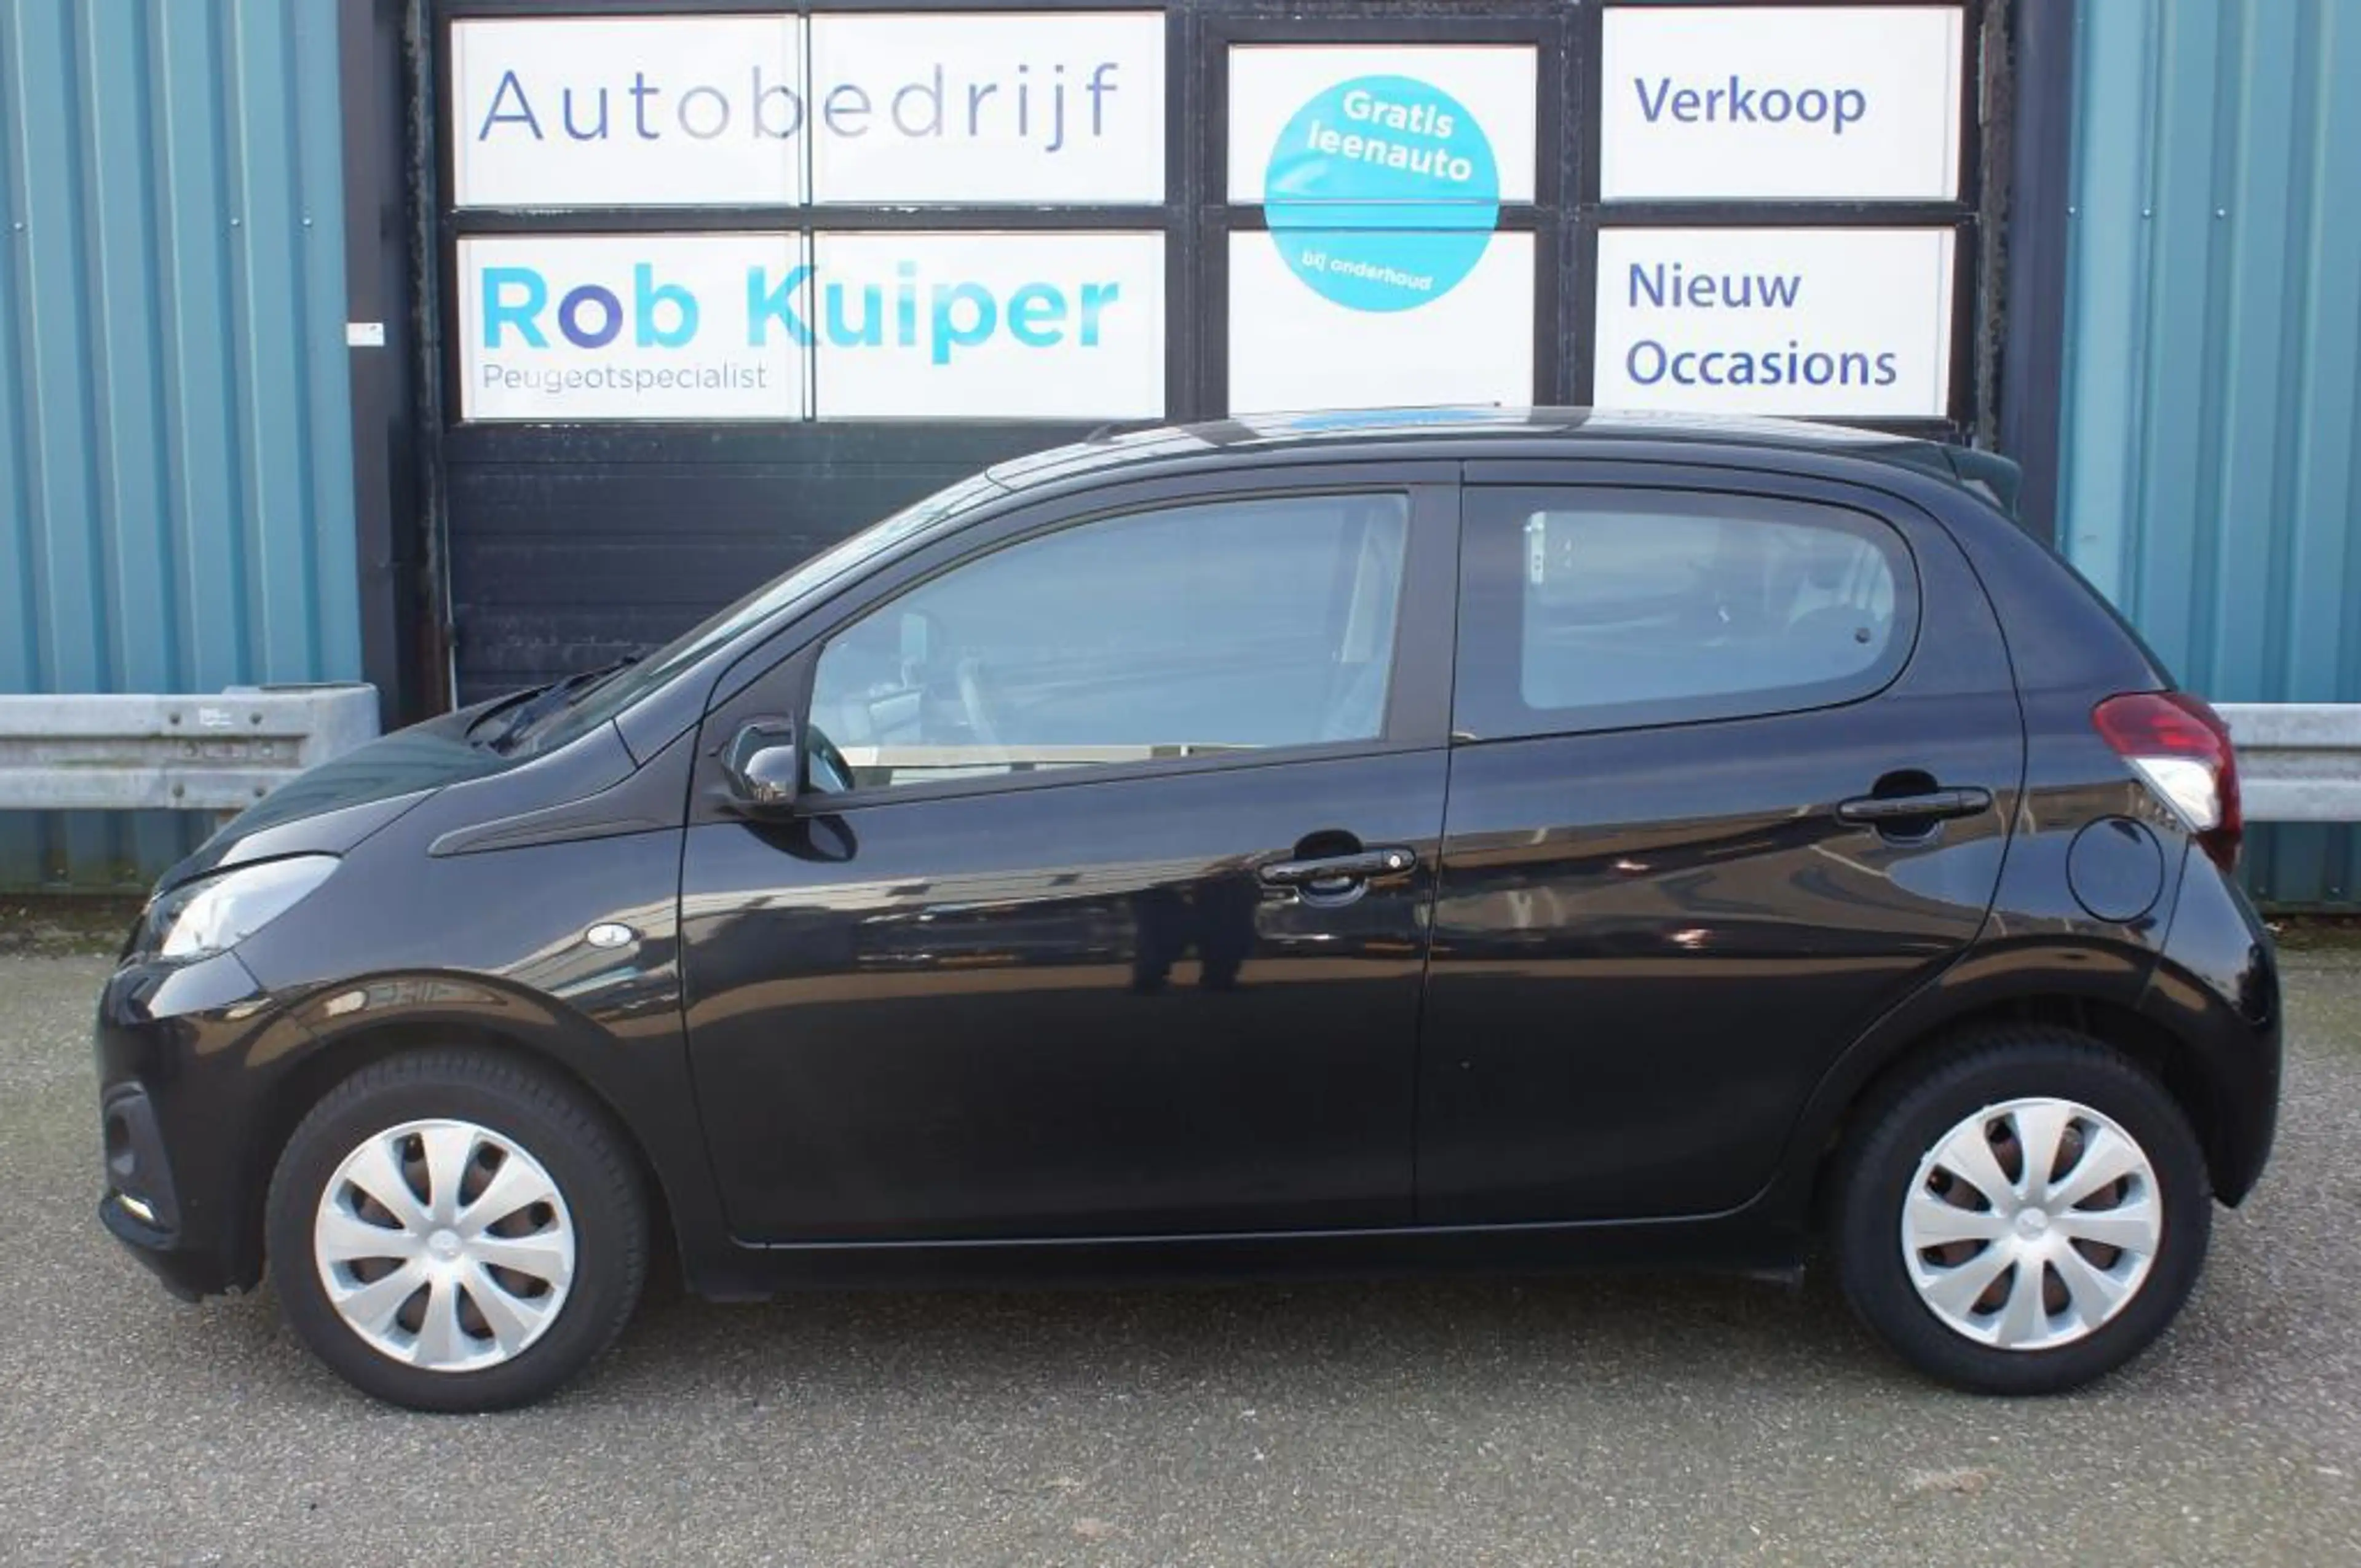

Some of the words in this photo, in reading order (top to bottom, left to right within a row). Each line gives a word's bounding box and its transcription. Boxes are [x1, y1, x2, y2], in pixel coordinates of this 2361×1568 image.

[478, 62, 1118, 152] Autobedrijf
[1343, 90, 1455, 138] Gratis
[1634, 75, 1867, 134] Verkoop
[1307, 119, 1472, 181] leenauto
[1302, 250, 1326, 271] bij
[1331, 258, 1433, 291] onderhoud
[1629, 263, 1801, 307] Nieuw
[481, 262, 700, 349] Rob
[747, 260, 1119, 365] Kuiper
[483, 362, 767, 394] Peugeotspecialist
[1626, 339, 1897, 386] Occasions
